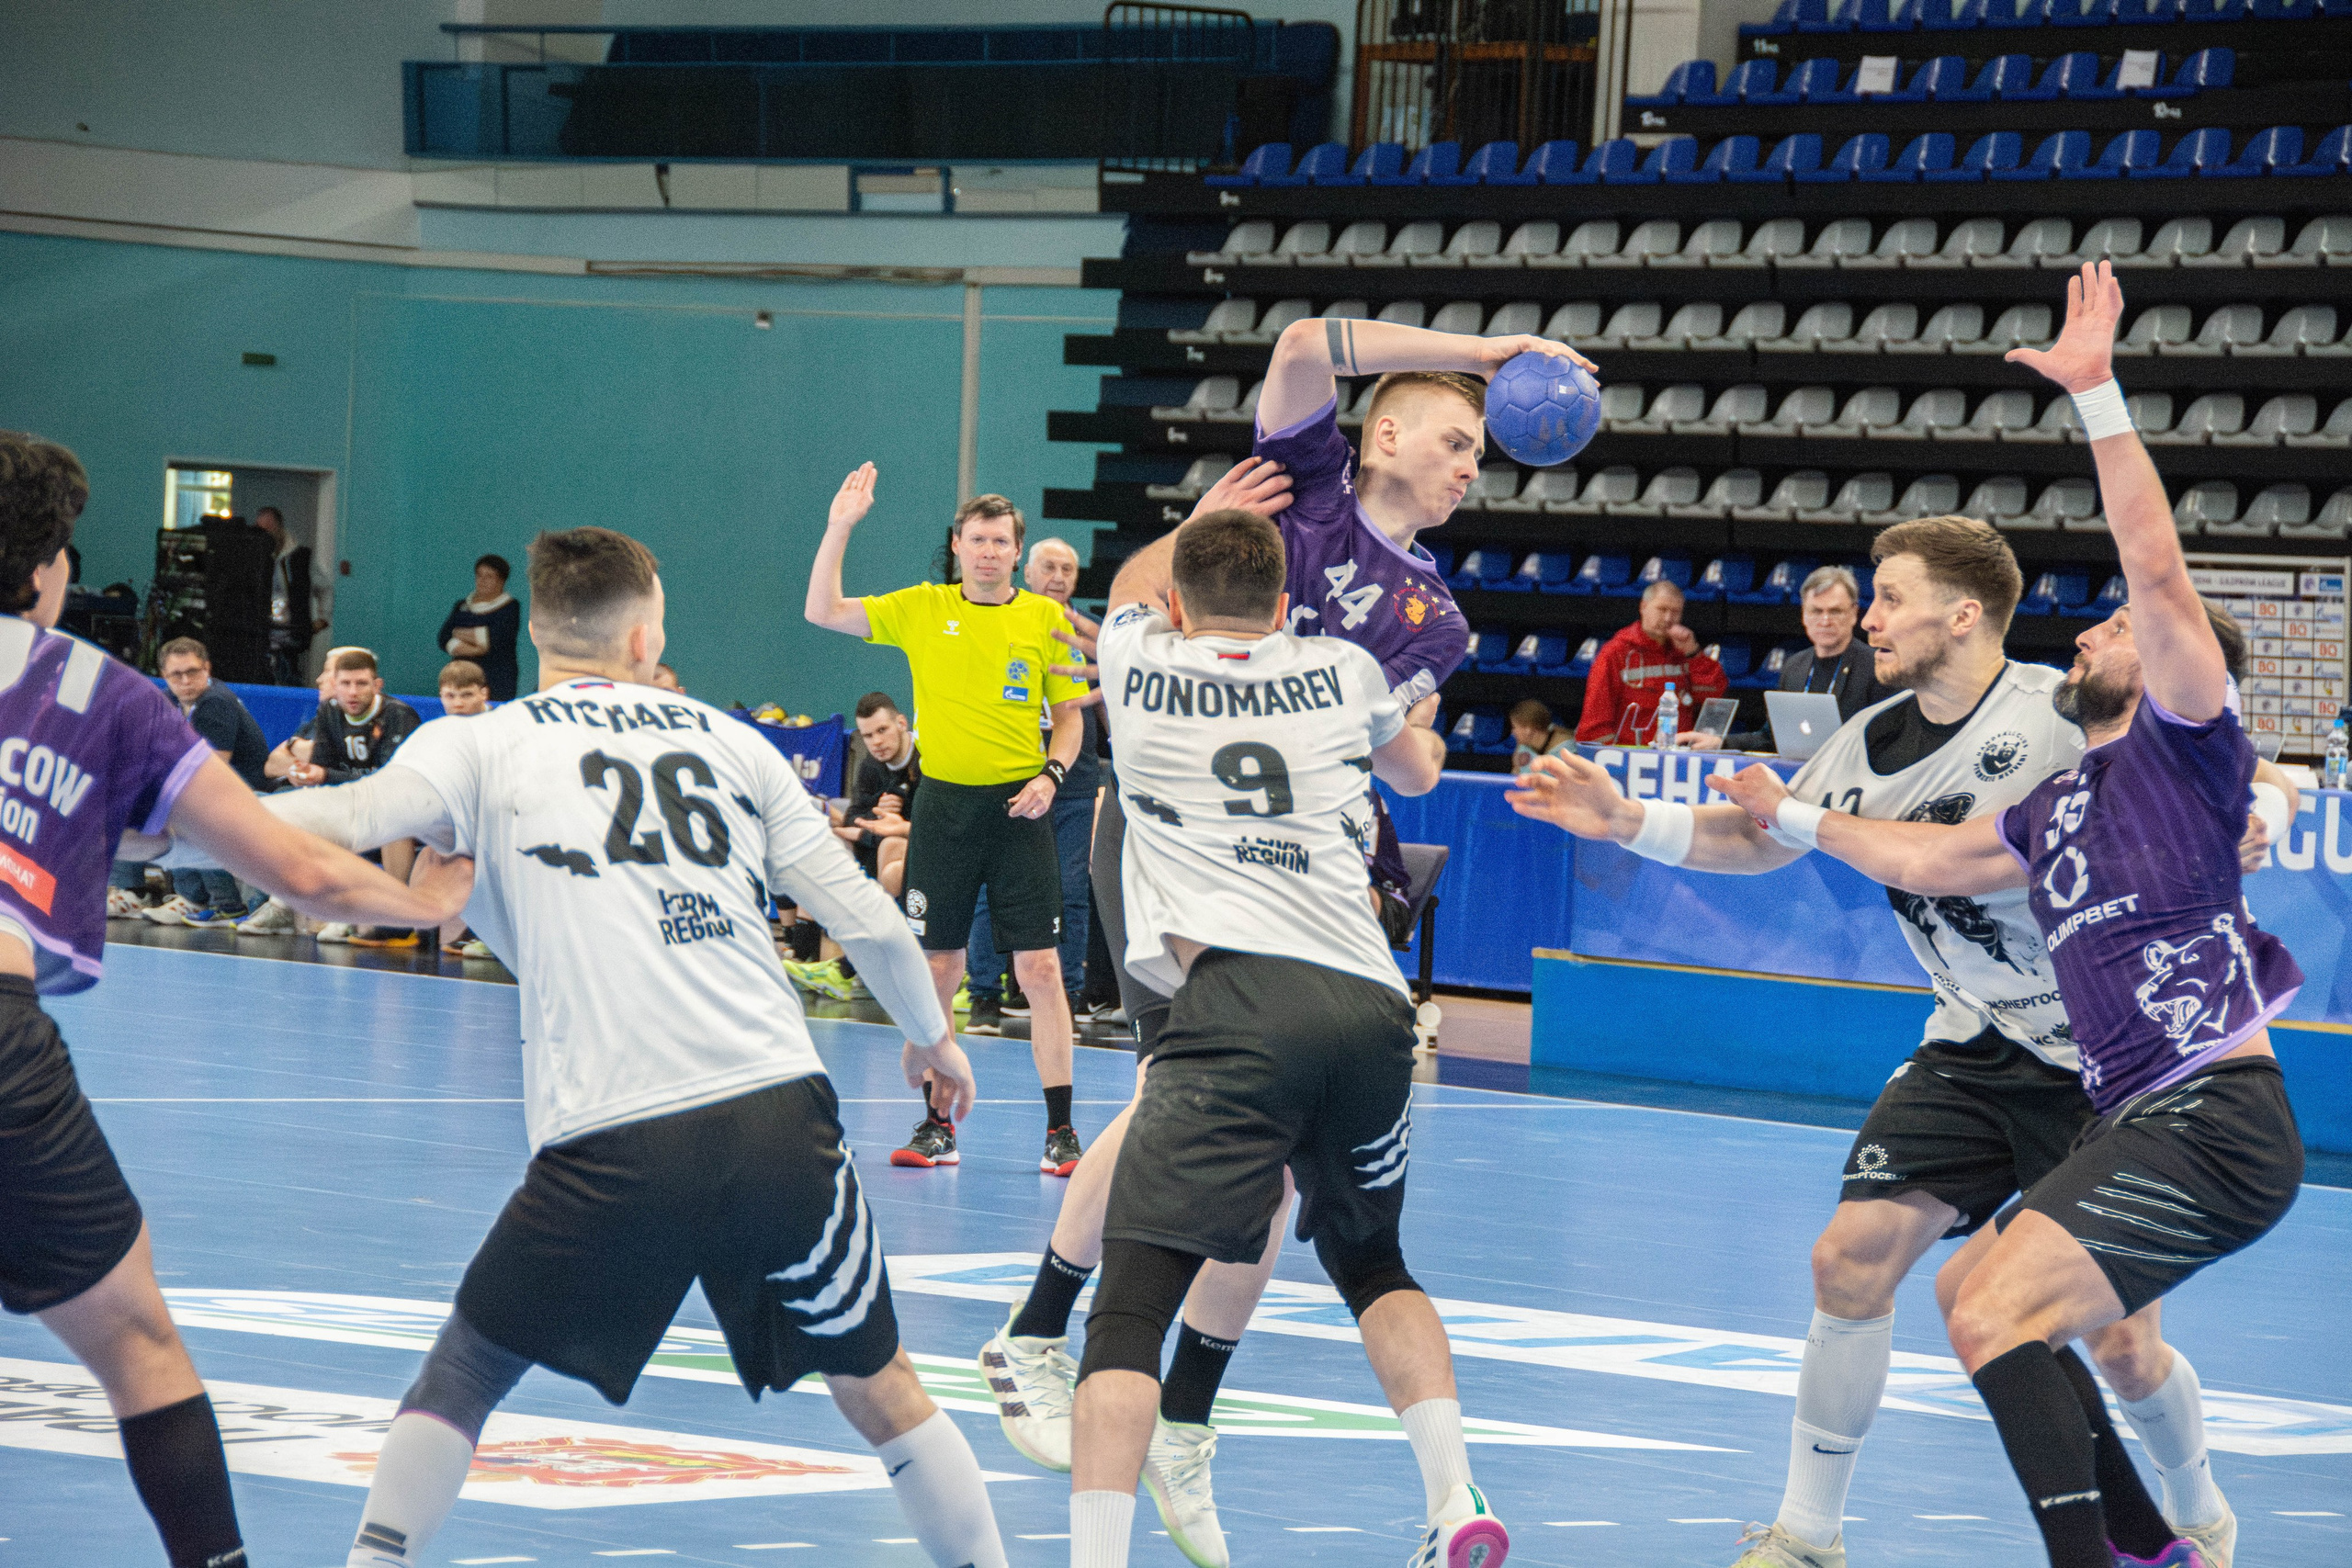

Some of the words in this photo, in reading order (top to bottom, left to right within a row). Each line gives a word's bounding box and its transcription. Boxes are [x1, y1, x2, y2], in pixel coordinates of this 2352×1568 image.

[1324, 558, 1384, 631] 44
[522, 696, 712, 734] RYCHAEV
[1123, 665, 1345, 717] PONOMAREV
[344, 735, 369, 761] 16
[1594, 749, 1736, 805] SEHA
[580, 749, 731, 868] 26
[1211, 740, 1295, 818] 9
[2259, 794, 2352, 874] GU
[2047, 893, 2139, 953] OLIMPBET
